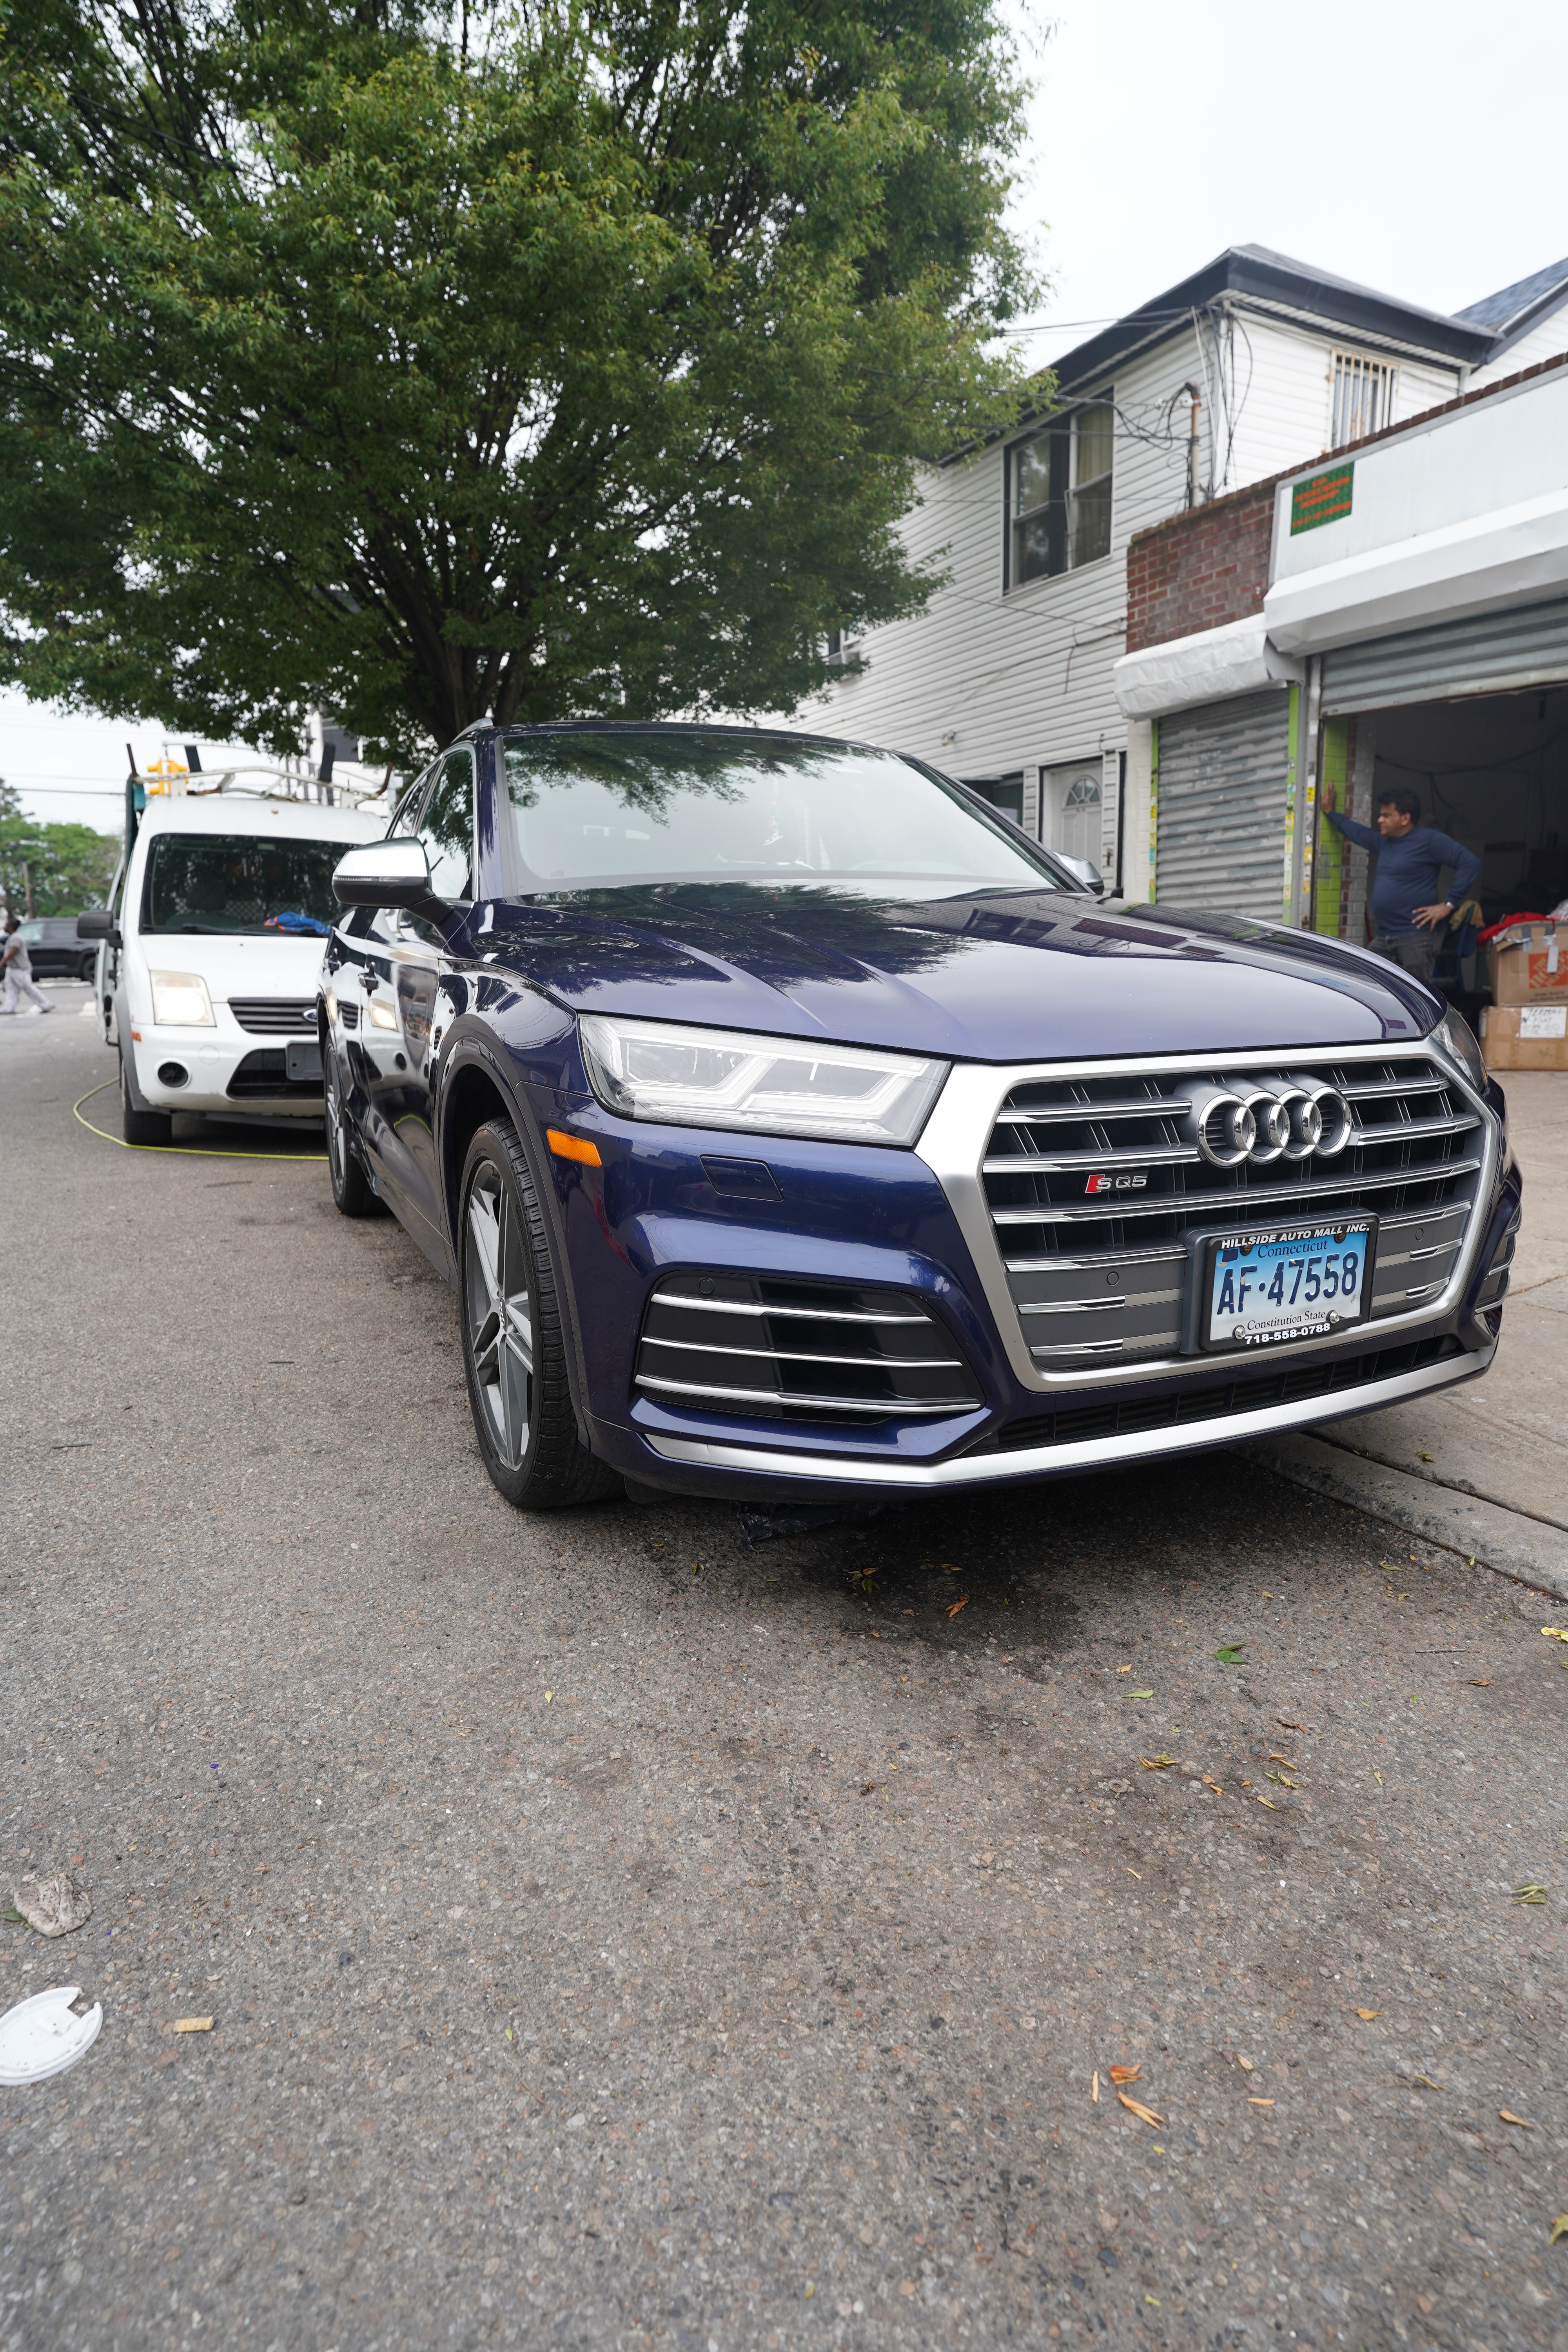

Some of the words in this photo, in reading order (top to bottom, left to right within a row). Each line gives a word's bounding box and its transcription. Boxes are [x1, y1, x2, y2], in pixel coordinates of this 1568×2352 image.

[1221, 1234, 1277, 1249] HILLSIDE
[1279, 1230, 1311, 1242] AUTO
[1314, 1226, 1343, 1238] MALL
[1346, 1223, 1369, 1233] INC.
[1258, 1239, 1328, 1258] Connecticut
[1247, 1314, 1301, 1330] Constitution
[1305, 1310, 1325, 1321] State
[1244, 1323, 1330, 1345] 718-558-0788
